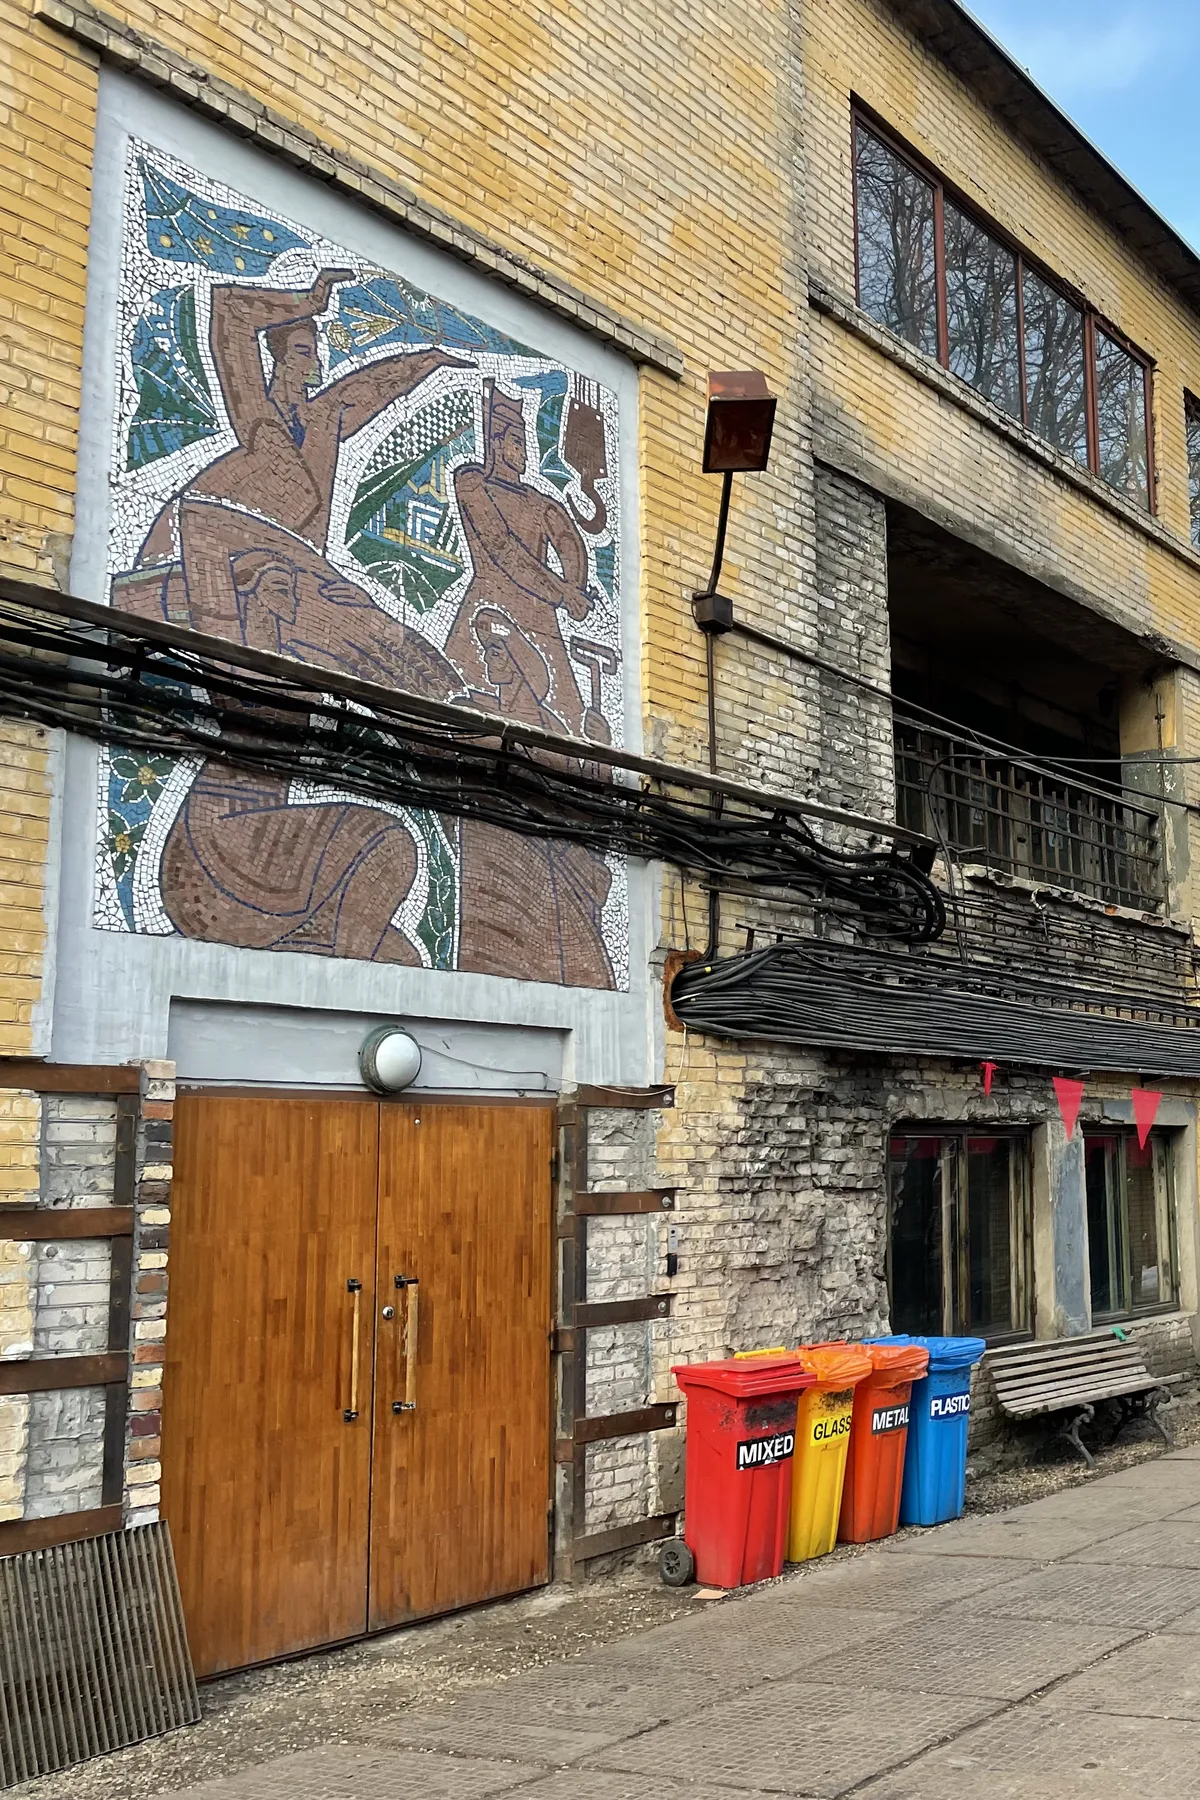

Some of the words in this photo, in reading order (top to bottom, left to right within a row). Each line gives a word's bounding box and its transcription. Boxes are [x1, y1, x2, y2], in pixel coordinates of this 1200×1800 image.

[873, 1406, 909, 1430] METAL
[931, 1394, 970, 1417] PLASTIC
[813, 1415, 851, 1441] GLASS
[739, 1434, 794, 1465] MIXED
